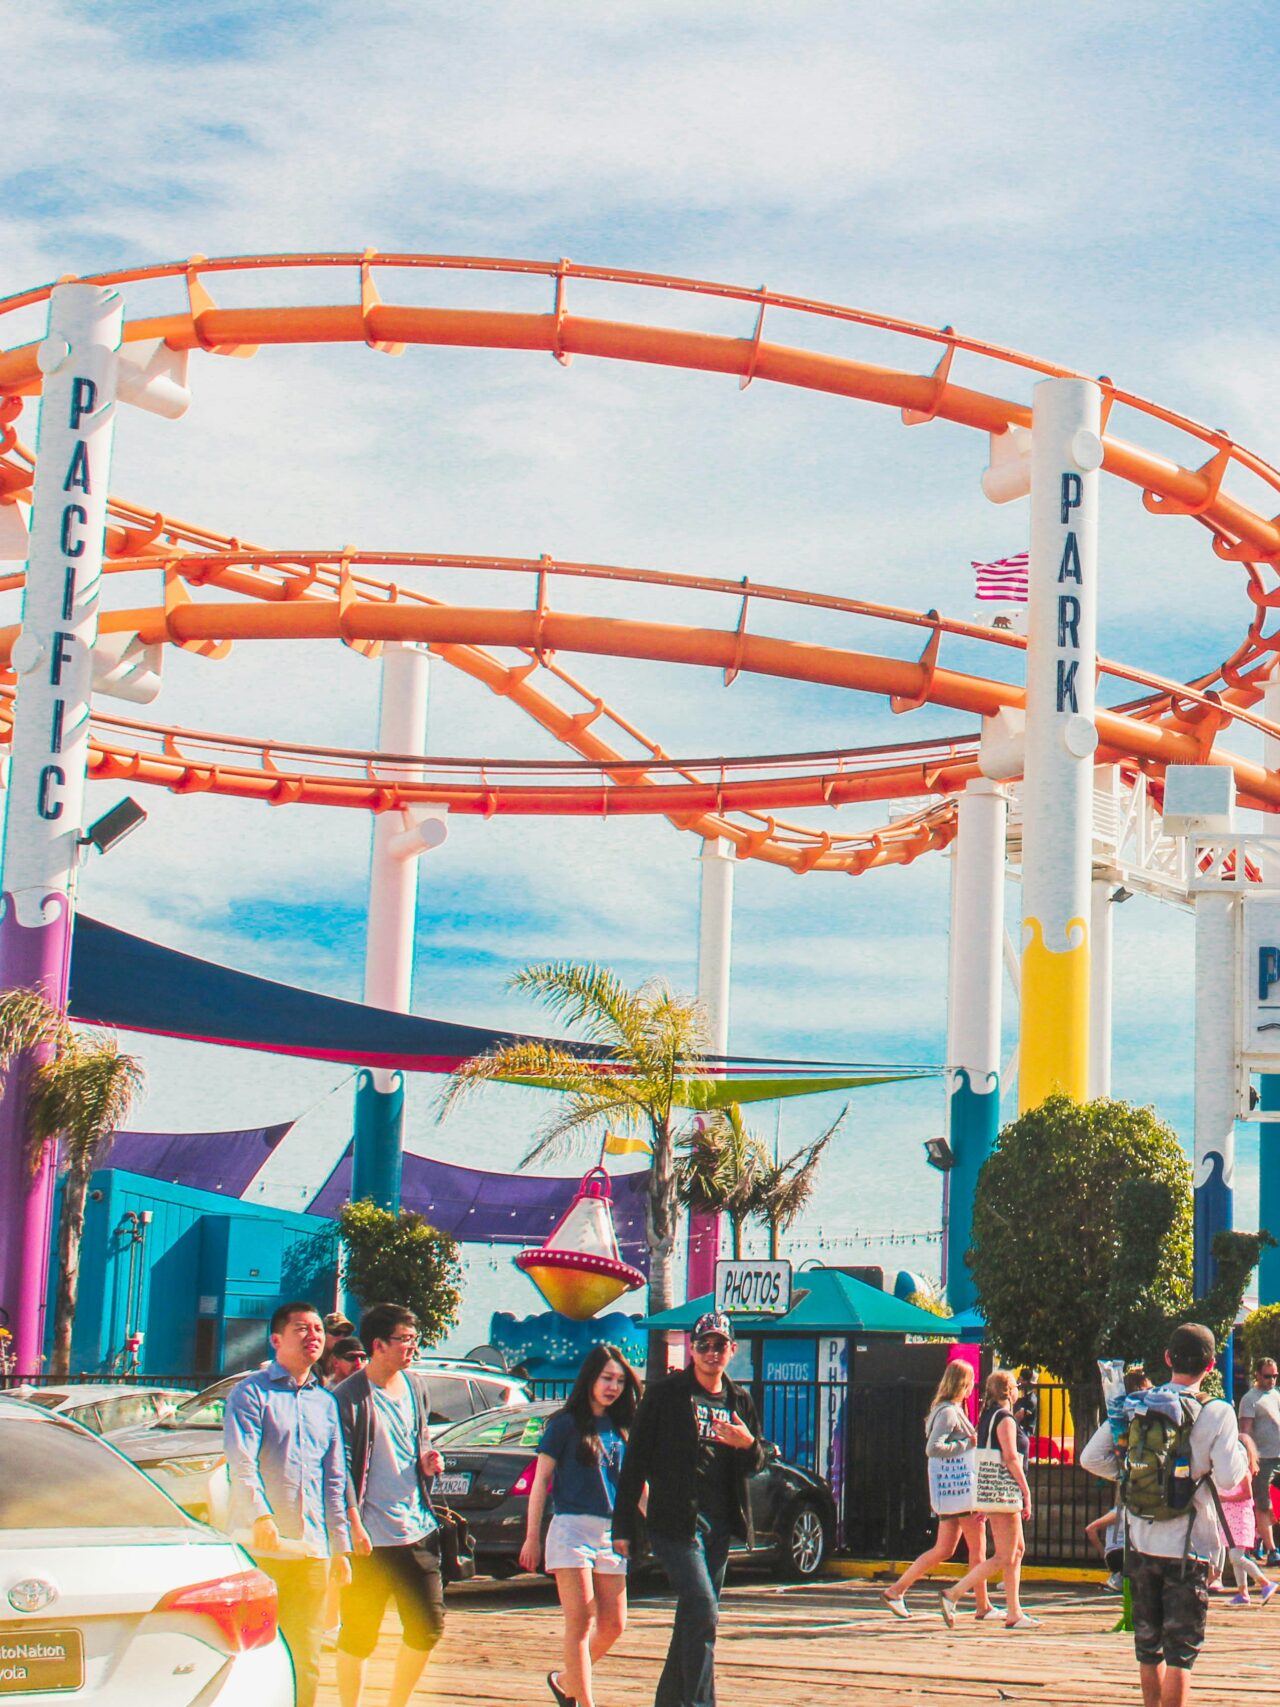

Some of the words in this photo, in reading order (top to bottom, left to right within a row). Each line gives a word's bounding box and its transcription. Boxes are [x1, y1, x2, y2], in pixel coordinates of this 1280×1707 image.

[38, 377, 99, 820] PACIFIC
[1056, 473, 1084, 714] PARK
[723, 1270, 781, 1304] PHOTOS
[767, 1363, 809, 1381] PHOTOS
[938, 1488, 970, 1496] FOREVER
[0, 1643, 65, 1659] toNation
